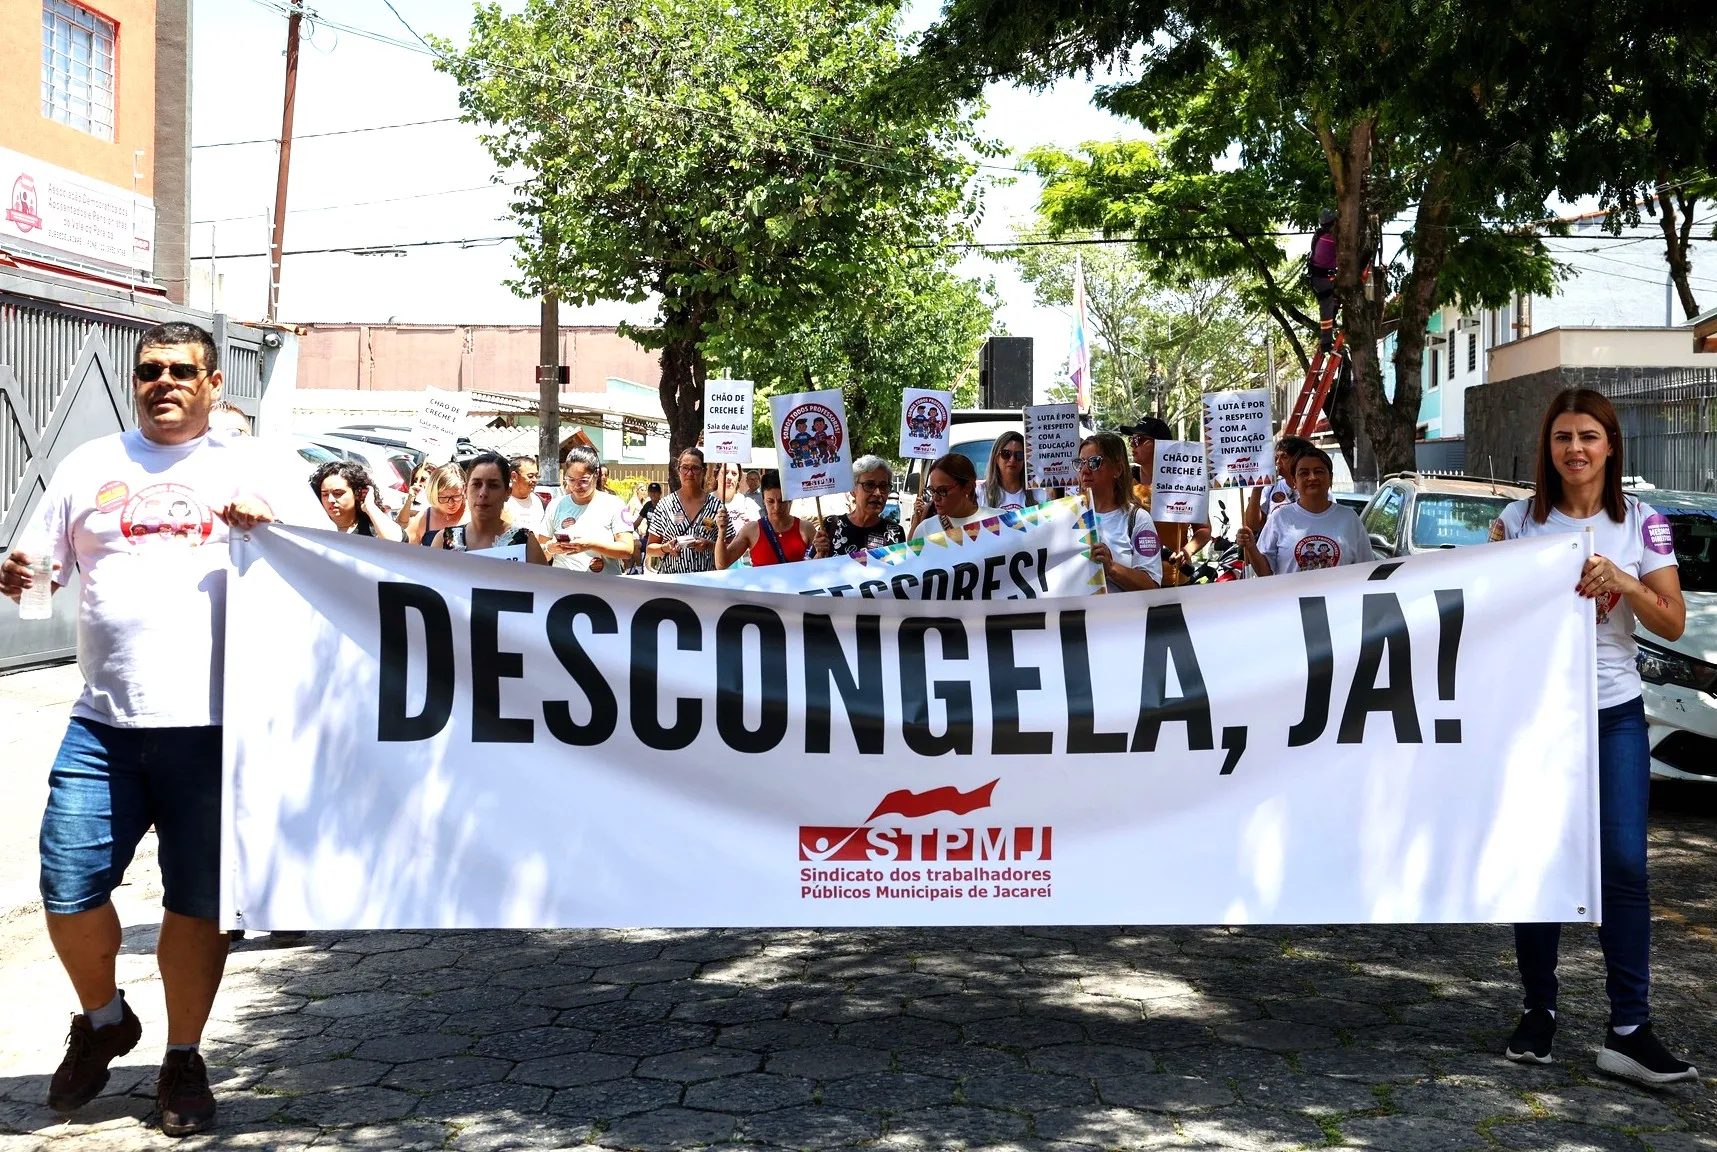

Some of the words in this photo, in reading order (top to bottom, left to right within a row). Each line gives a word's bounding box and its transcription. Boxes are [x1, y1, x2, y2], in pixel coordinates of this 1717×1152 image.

[712, 392, 732, 402] CHÃO
[740, 405, 744, 414] É
[1218, 402, 1239, 410] LUTA
[1241, 401, 1245, 409] É
[425, 408, 451, 421] CRECHE
[1226, 412, 1263, 421] RESPEITO
[783, 418, 793, 440] SOMOS
[791, 406, 809, 420] TODOS
[810, 406, 841, 434] PROFESSORES!
[1220, 433, 1265, 443] EDUCAÇÃO
[1039, 441, 1075, 449] EDUCAÇÃO
[1221, 446, 1262, 454] INFANTIL!
[1163, 453, 1189, 462] CHÃO
[1160, 466, 1194, 475] CRECHE
[1197, 467, 1202, 475] É
[378, 581, 1248, 775] DESCONGELA,
[1288, 562, 1464, 744] JÁ!
[865, 826, 1043, 862] STPMJ
[800, 868, 884, 882] Sindicato
[890, 868, 921, 882] dos
[926, 867, 1052, 882] trabalhadores
[801, 884, 871, 899] Públicos
[876, 885, 963, 902] Municipais
[968, 884, 988, 898] de
[992, 884, 1052, 898] Jacareí
